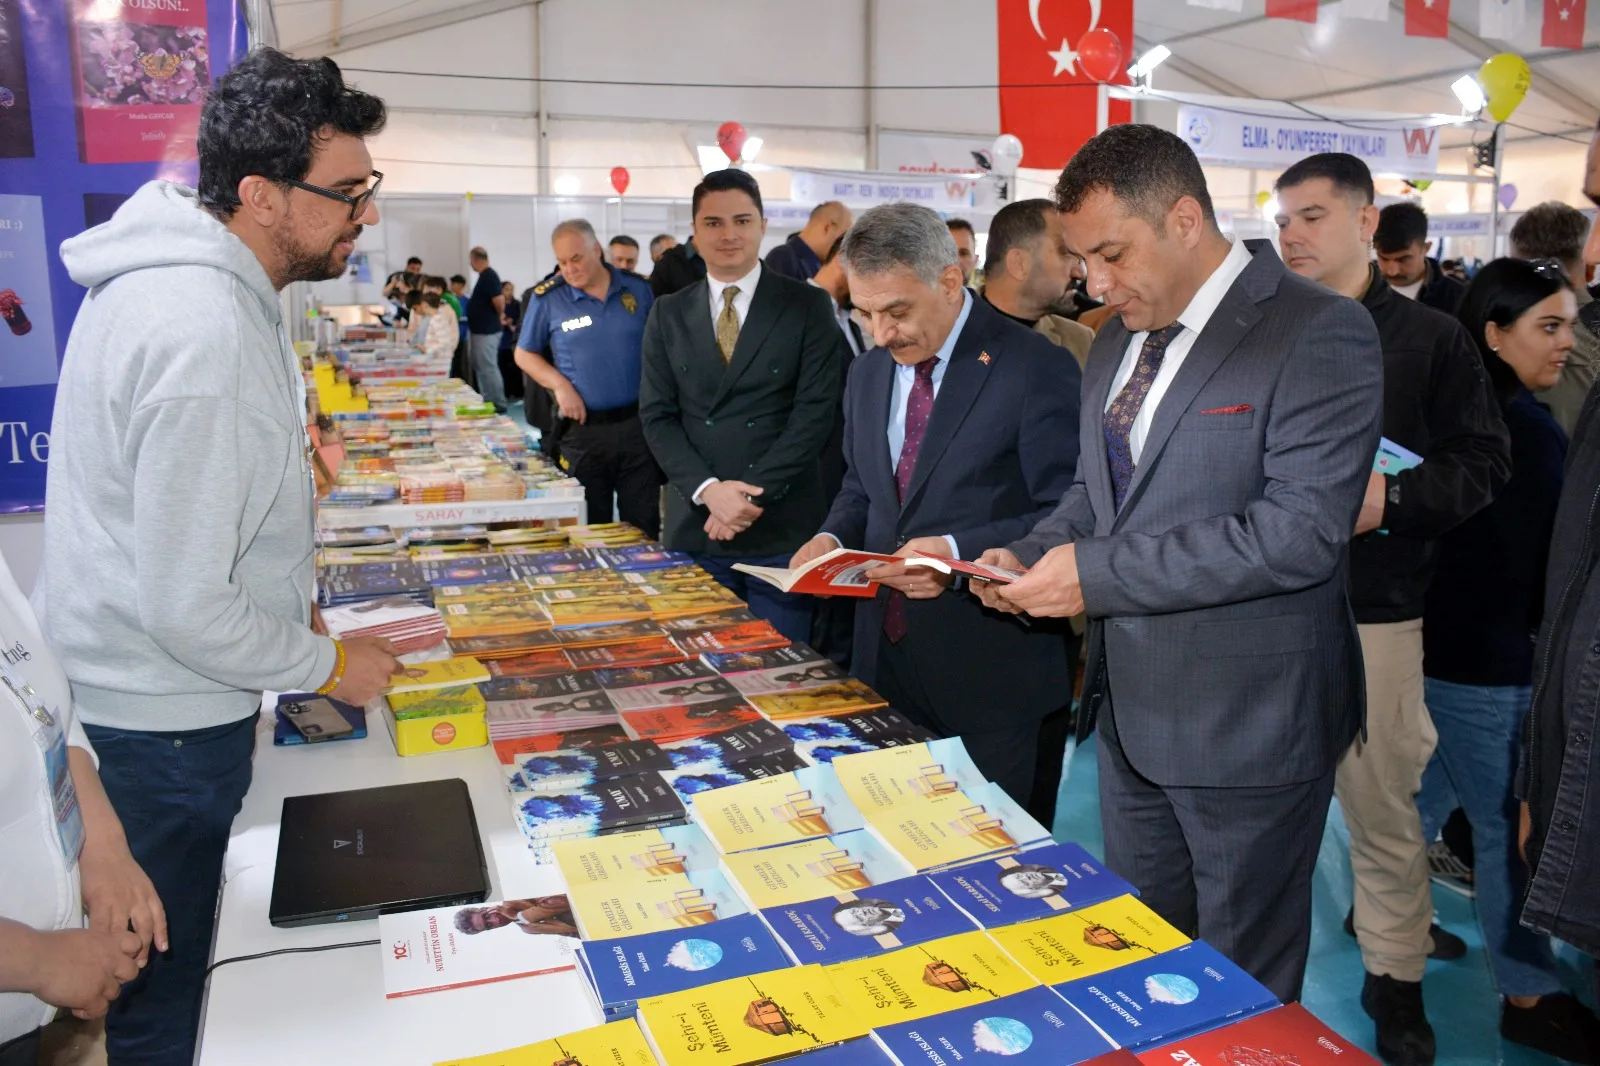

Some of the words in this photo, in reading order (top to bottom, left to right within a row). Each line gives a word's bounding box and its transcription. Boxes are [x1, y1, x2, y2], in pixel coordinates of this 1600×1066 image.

[1243, 126, 1268, 149] ELMA
[1277, 128, 1338, 153] OYUNPEREST
[1341, 134, 1387, 157] YAYINLARI
[414, 508, 465, 522] SARAY
[429, 916, 438, 938] ORHAN
[785, 911, 812, 934] KARAKOÇ
[805, 934, 826, 950] SEZAİ
[1021, 939, 1059, 966] Şehr-i
[432, 939, 444, 971] NURETTİN
[619, 962, 636, 986] MİMESİS
[859, 977, 892, 1008] Şehr-i
[1088, 986, 1113, 1003] ISLAĞI
[1109, 1003, 1142, 1027] MİMESİS
[677, 1013, 704, 1052] Şehr-i
